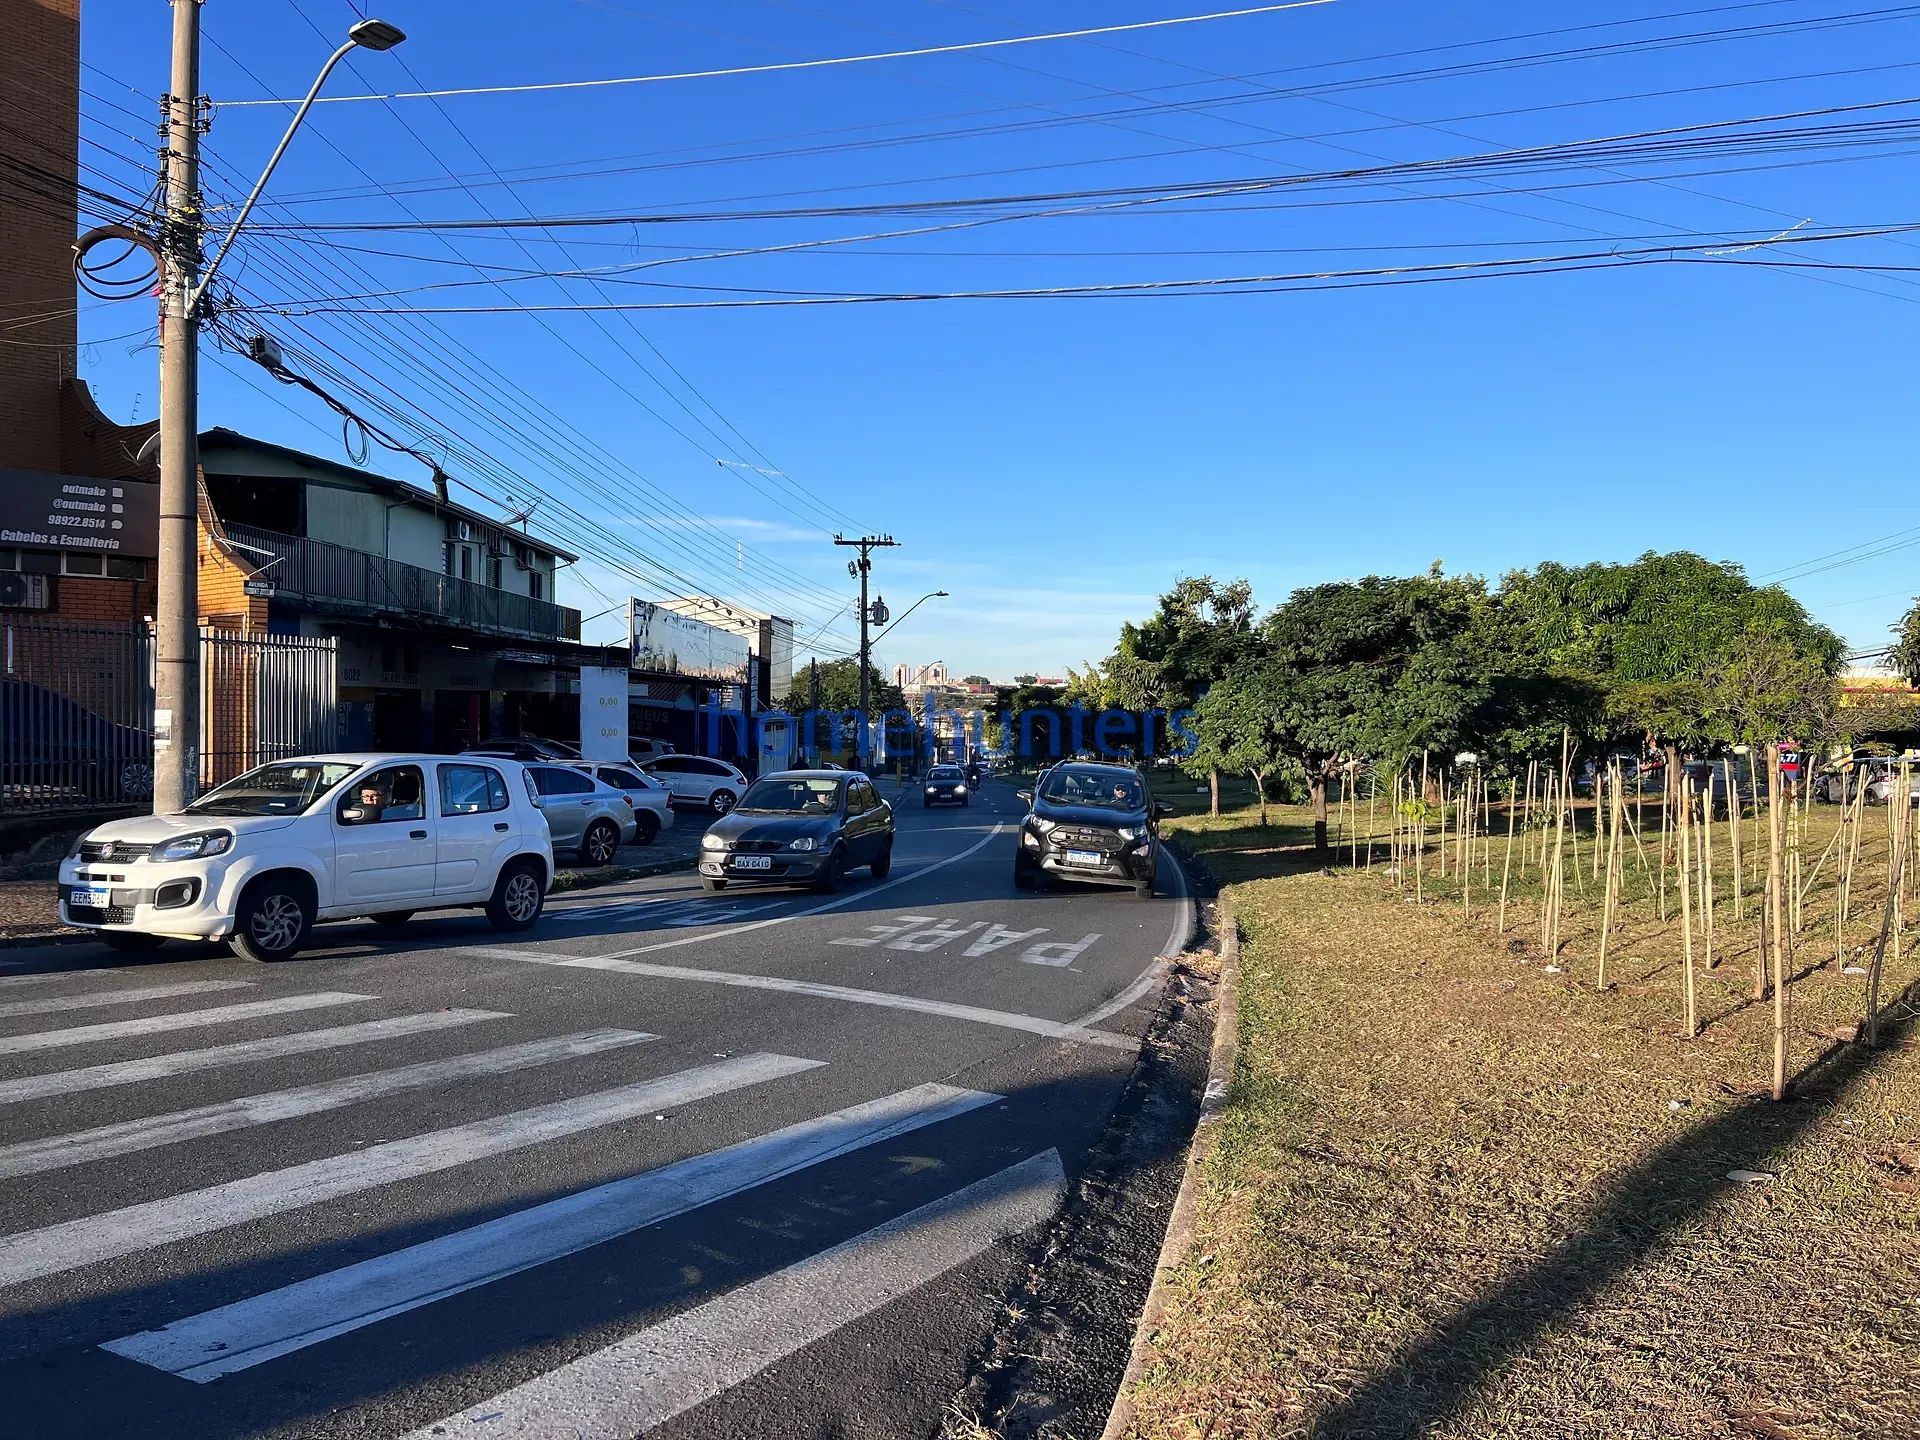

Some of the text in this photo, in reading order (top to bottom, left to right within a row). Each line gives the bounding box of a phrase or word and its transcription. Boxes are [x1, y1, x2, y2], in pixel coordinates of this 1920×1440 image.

[62, 483, 107, 497] outmake
[52, 498, 106, 512] @outmake
[48, 514, 106, 529] 98922.8514
[0, 529, 120, 550] Cabelos & Esmalteria
[599, 697, 618, 707] 0,00
[601, 728, 618, 738] 0,00
[827, 915, 1103, 968] PARE
